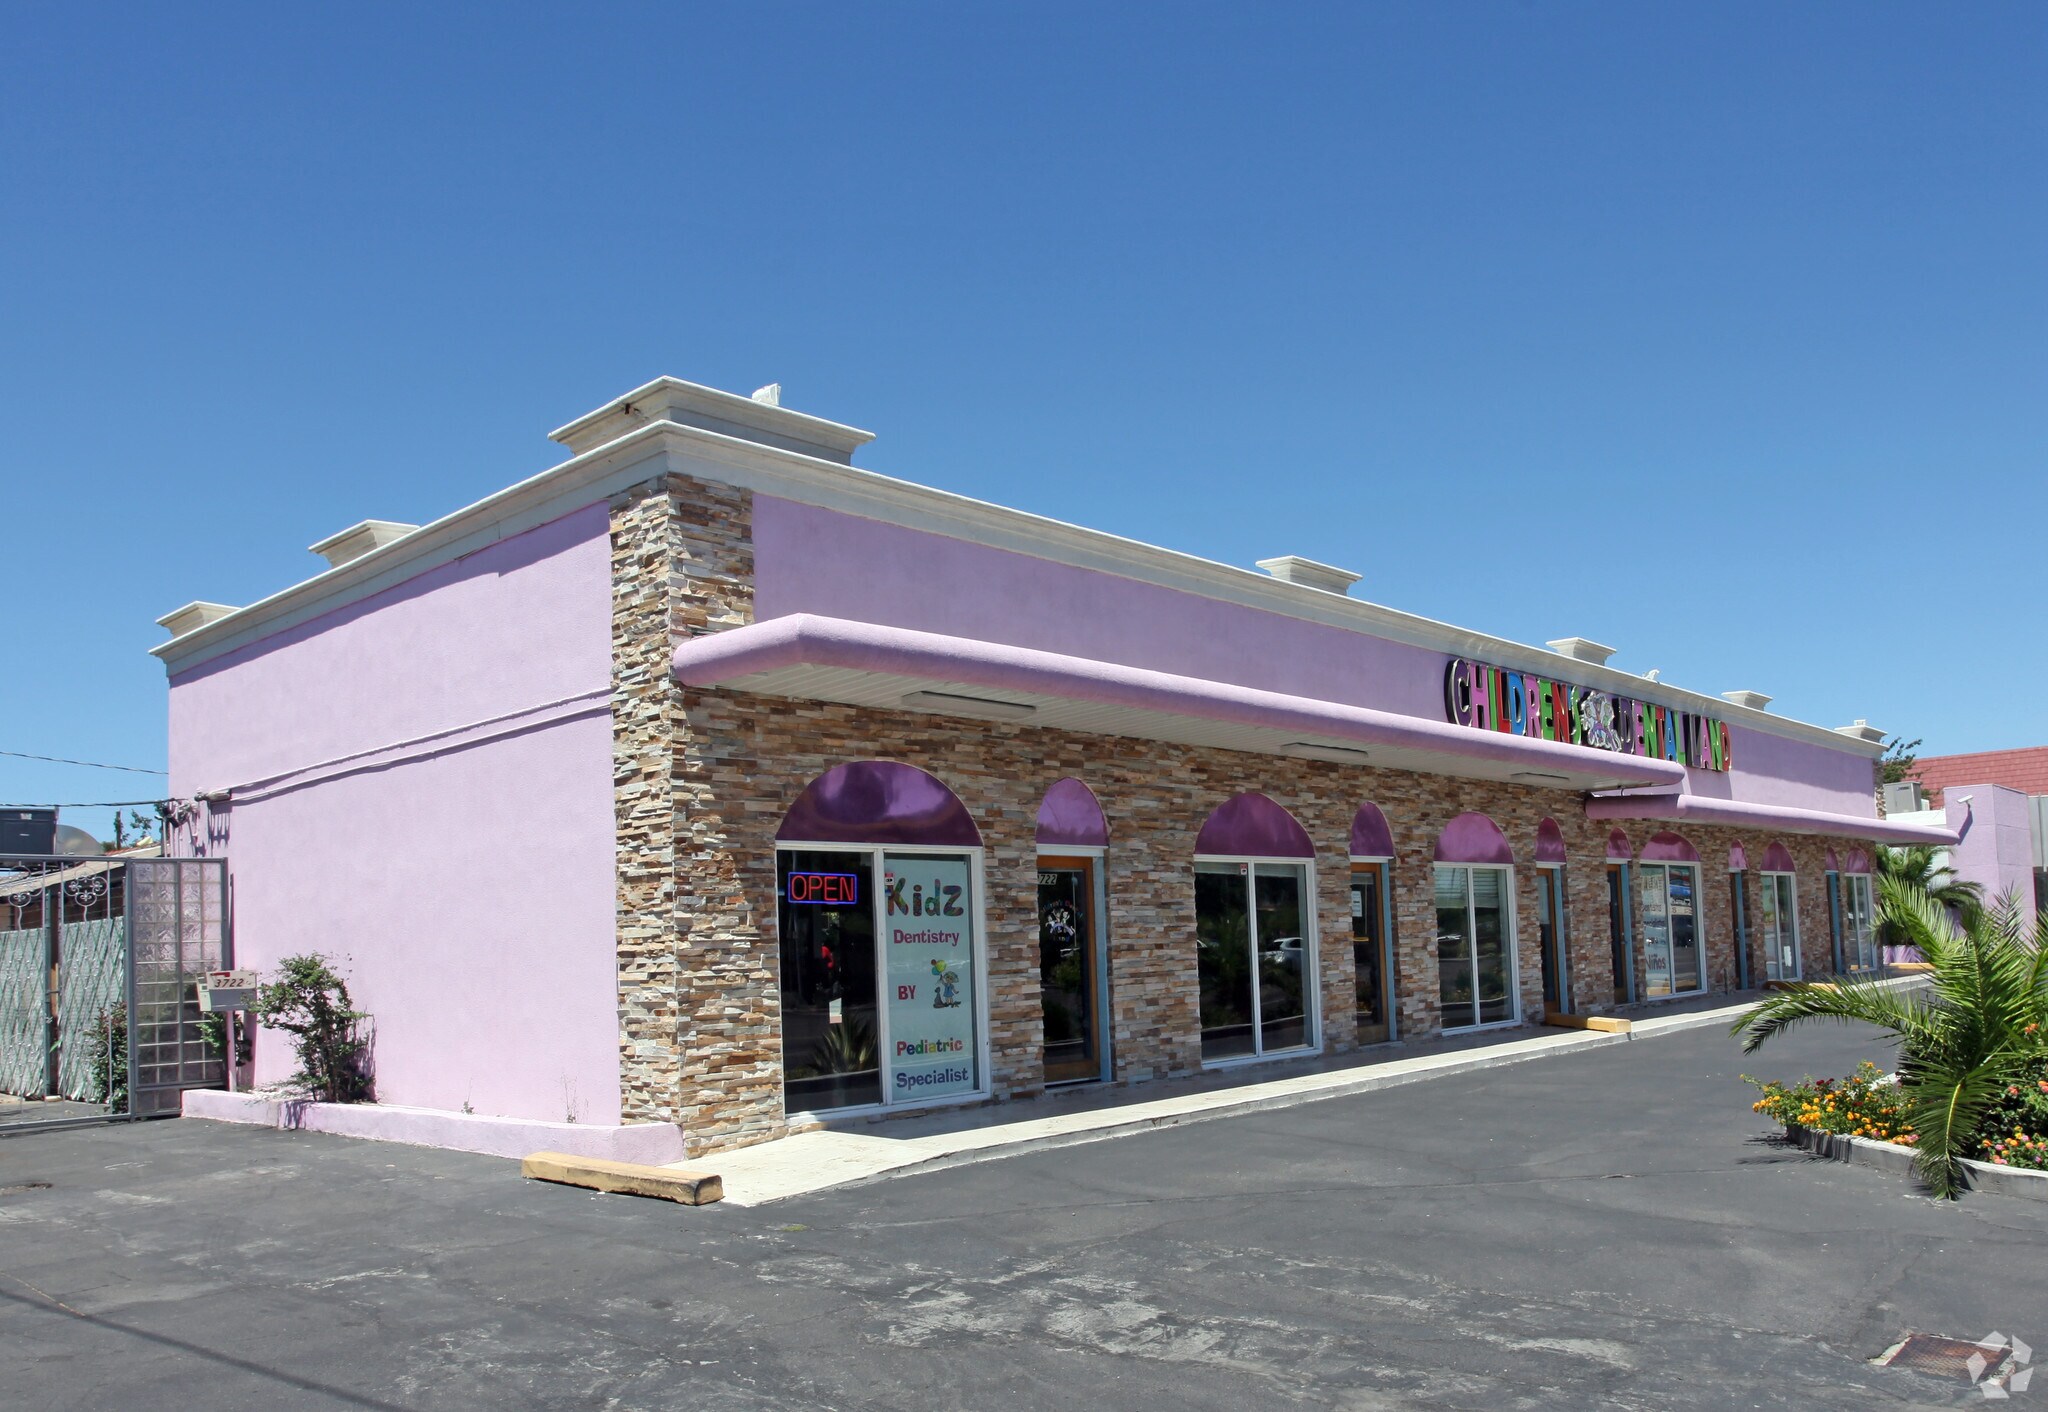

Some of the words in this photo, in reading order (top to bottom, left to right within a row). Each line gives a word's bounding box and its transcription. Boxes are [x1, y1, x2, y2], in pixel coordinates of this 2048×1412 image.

[1619, 697, 1686, 767] DENTAL
[1688, 712, 1732, 773] LAND
[792, 875, 854, 901] OPEN
[1037, 874, 1056, 885] 722
[893, 929, 960, 947] Dentistry
[214, 978, 245, 988] 3722
[897, 985, 917, 1000] BY
[896, 1038, 964, 1056] Pediatric
[896, 1067, 969, 1090] Specialist
